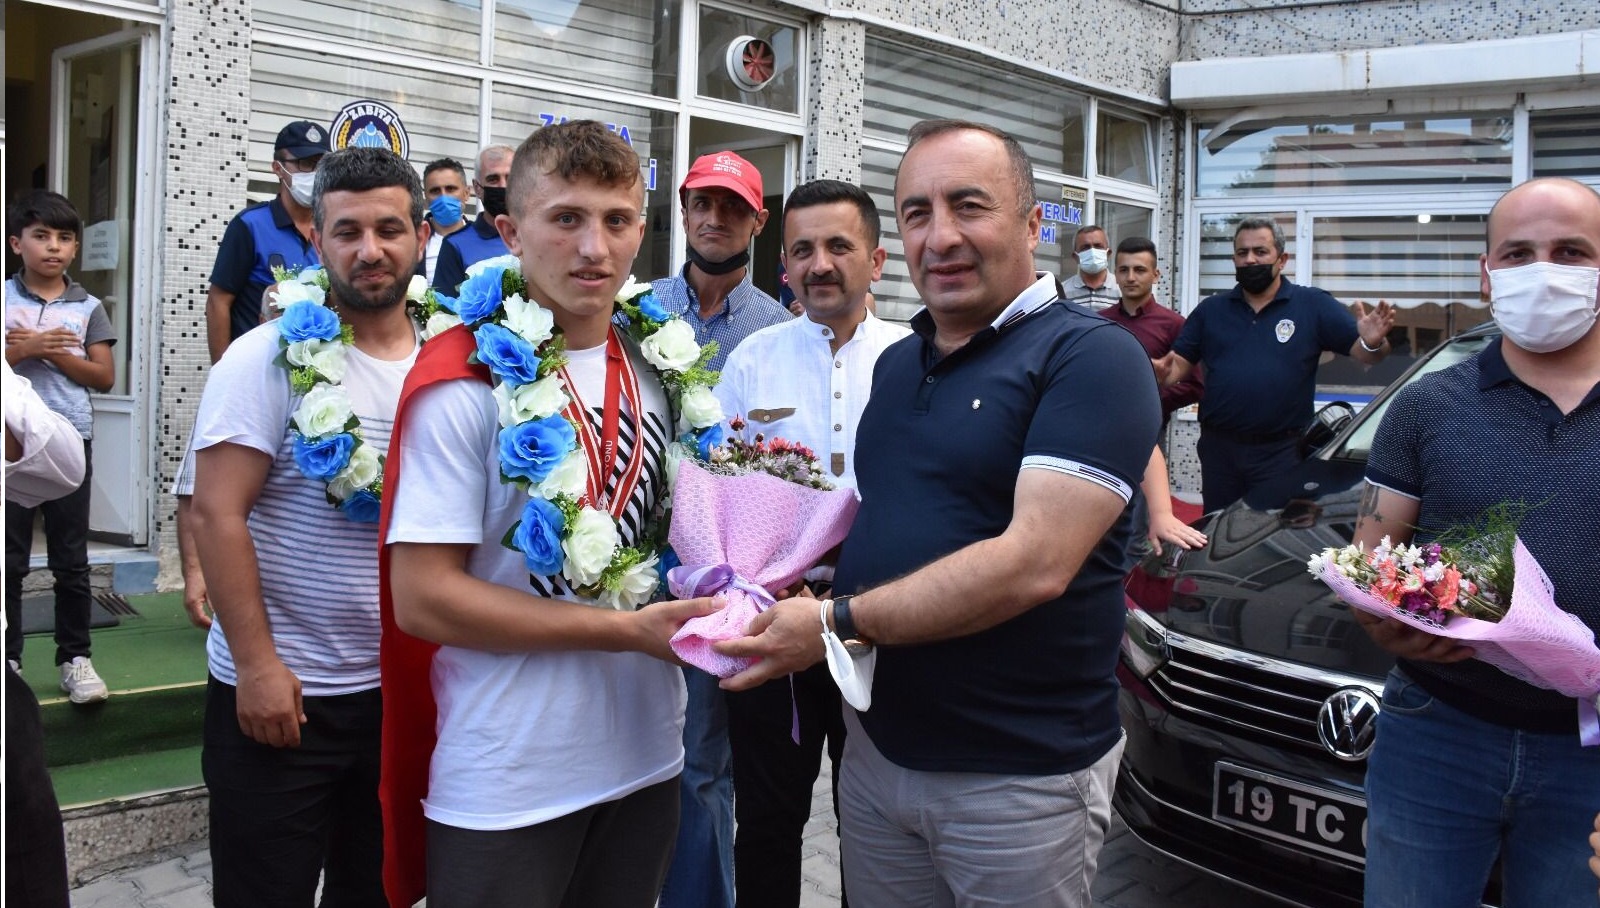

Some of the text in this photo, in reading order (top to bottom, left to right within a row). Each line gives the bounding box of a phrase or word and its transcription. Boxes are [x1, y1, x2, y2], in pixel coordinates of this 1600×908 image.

[348, 104, 393, 126] ZABITA
[1040, 222, 1056, 244] Mİ
[1227, 780, 1274, 822] 19
[1288, 794, 1346, 843] TC
